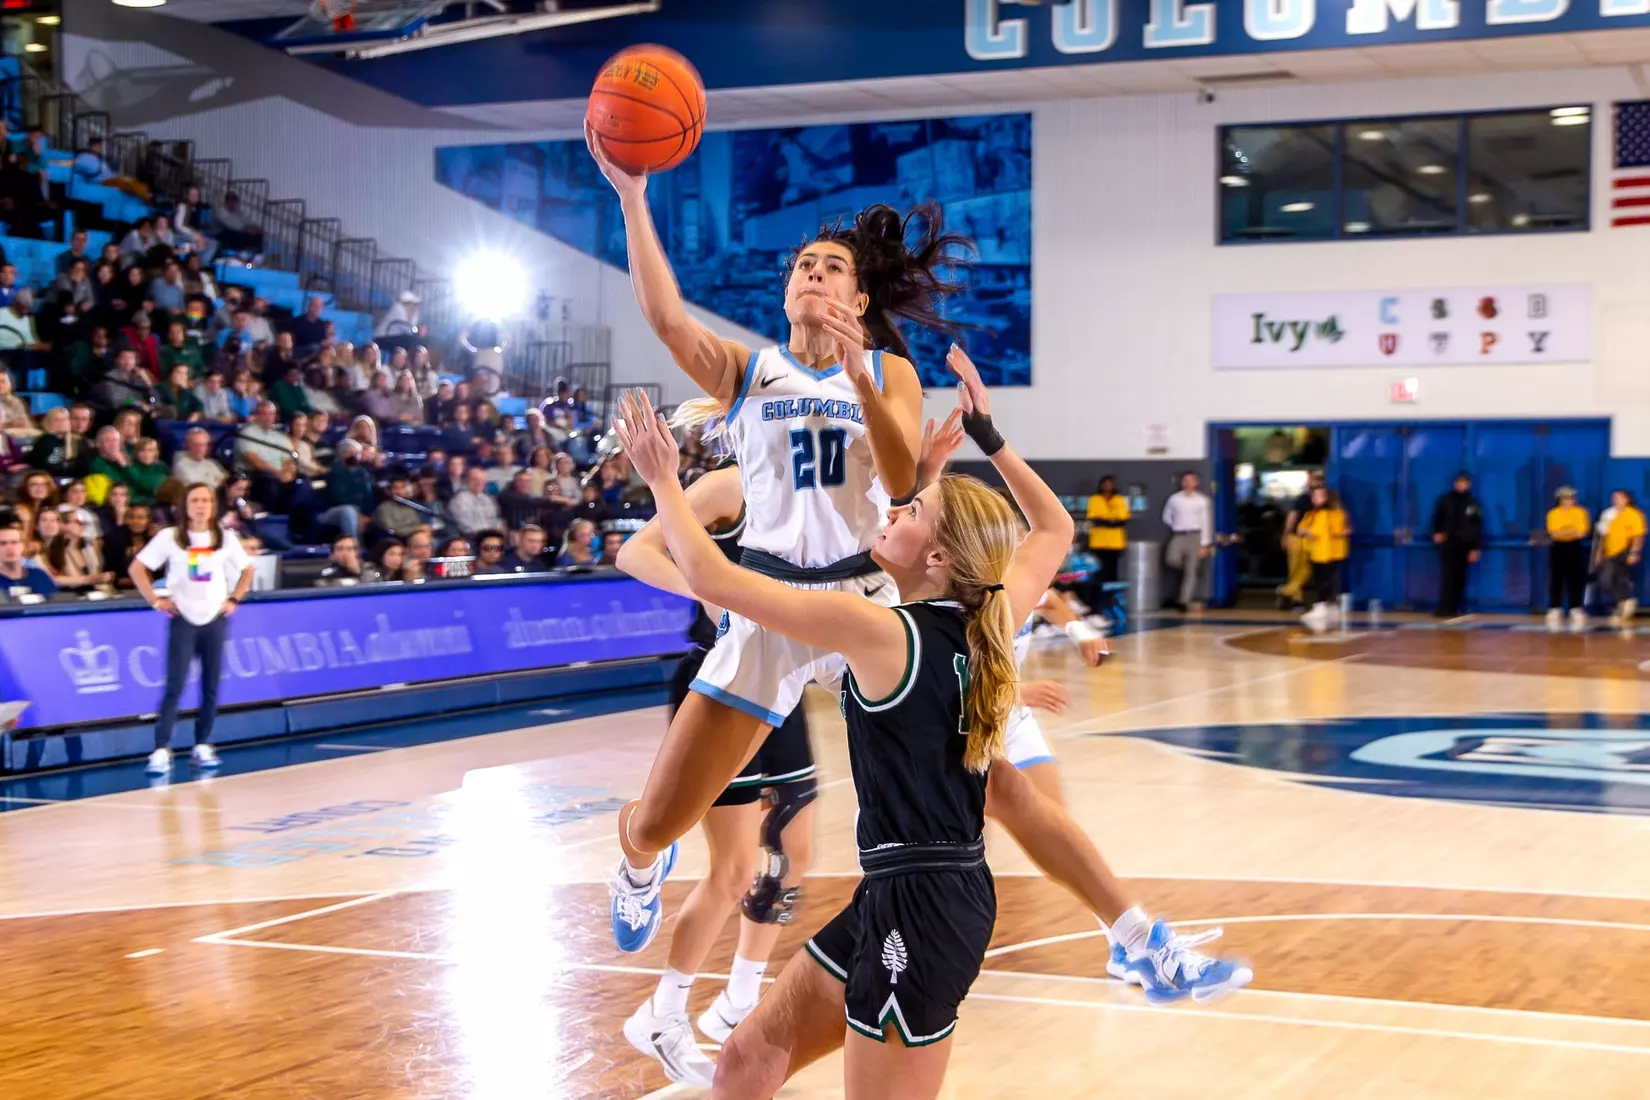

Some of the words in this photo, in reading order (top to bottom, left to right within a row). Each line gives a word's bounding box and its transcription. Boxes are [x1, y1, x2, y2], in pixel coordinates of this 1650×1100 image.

[1251, 311, 1311, 352] Ivy
[1480, 331, 1497, 354] P
[1527, 331, 1549, 352] Y
[761, 397, 867, 425] COLUMBI
[788, 427, 849, 492] 20
[187, 547, 212, 582] C
[128, 628, 366, 688] CUMBIA
